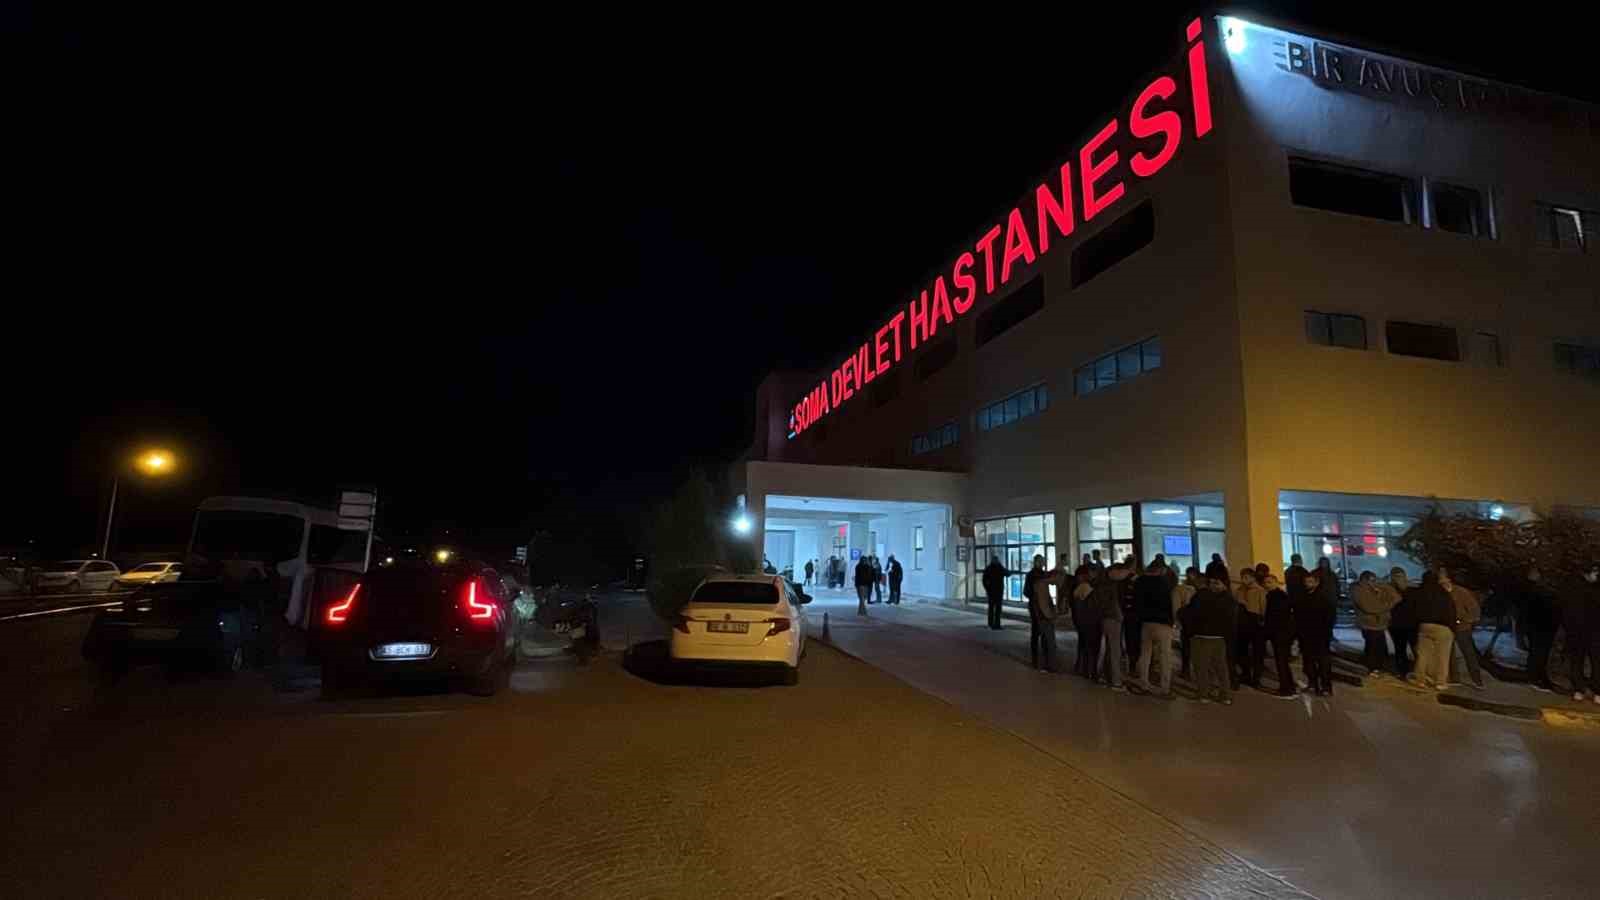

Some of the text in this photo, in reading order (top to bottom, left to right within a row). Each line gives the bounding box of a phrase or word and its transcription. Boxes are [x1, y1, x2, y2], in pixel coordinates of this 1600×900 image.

[795, 17, 1212, 434] SOMA DEVLET HASTANESİ
